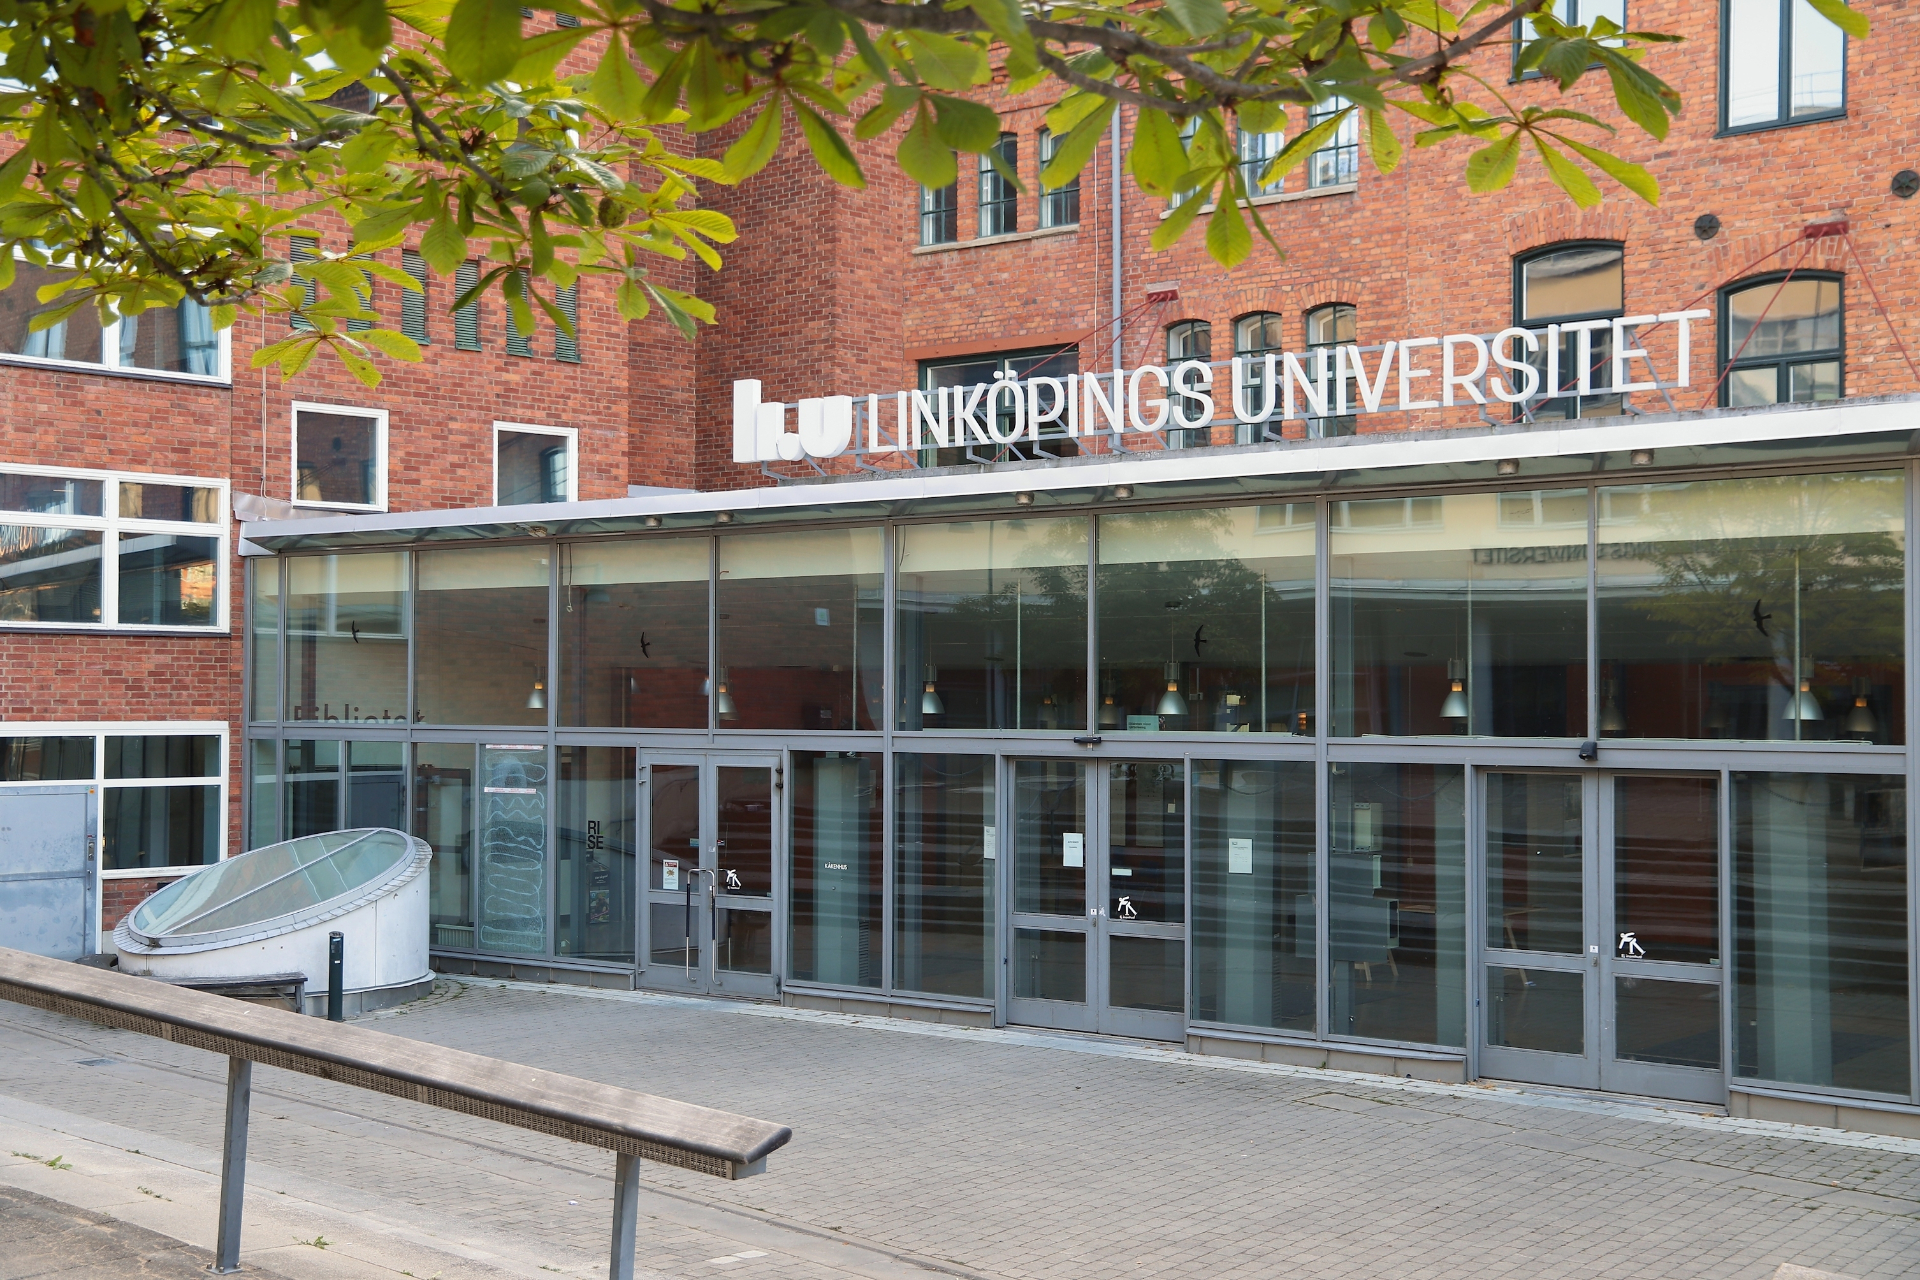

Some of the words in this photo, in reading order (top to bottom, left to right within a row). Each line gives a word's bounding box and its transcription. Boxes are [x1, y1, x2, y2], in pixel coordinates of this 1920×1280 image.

[868, 360, 1215, 453] LINKÖPINGS
[1232, 309, 1711, 424] UNIVERSITET
[587, 820, 600, 835] RI
[587, 835, 604, 850] SE
